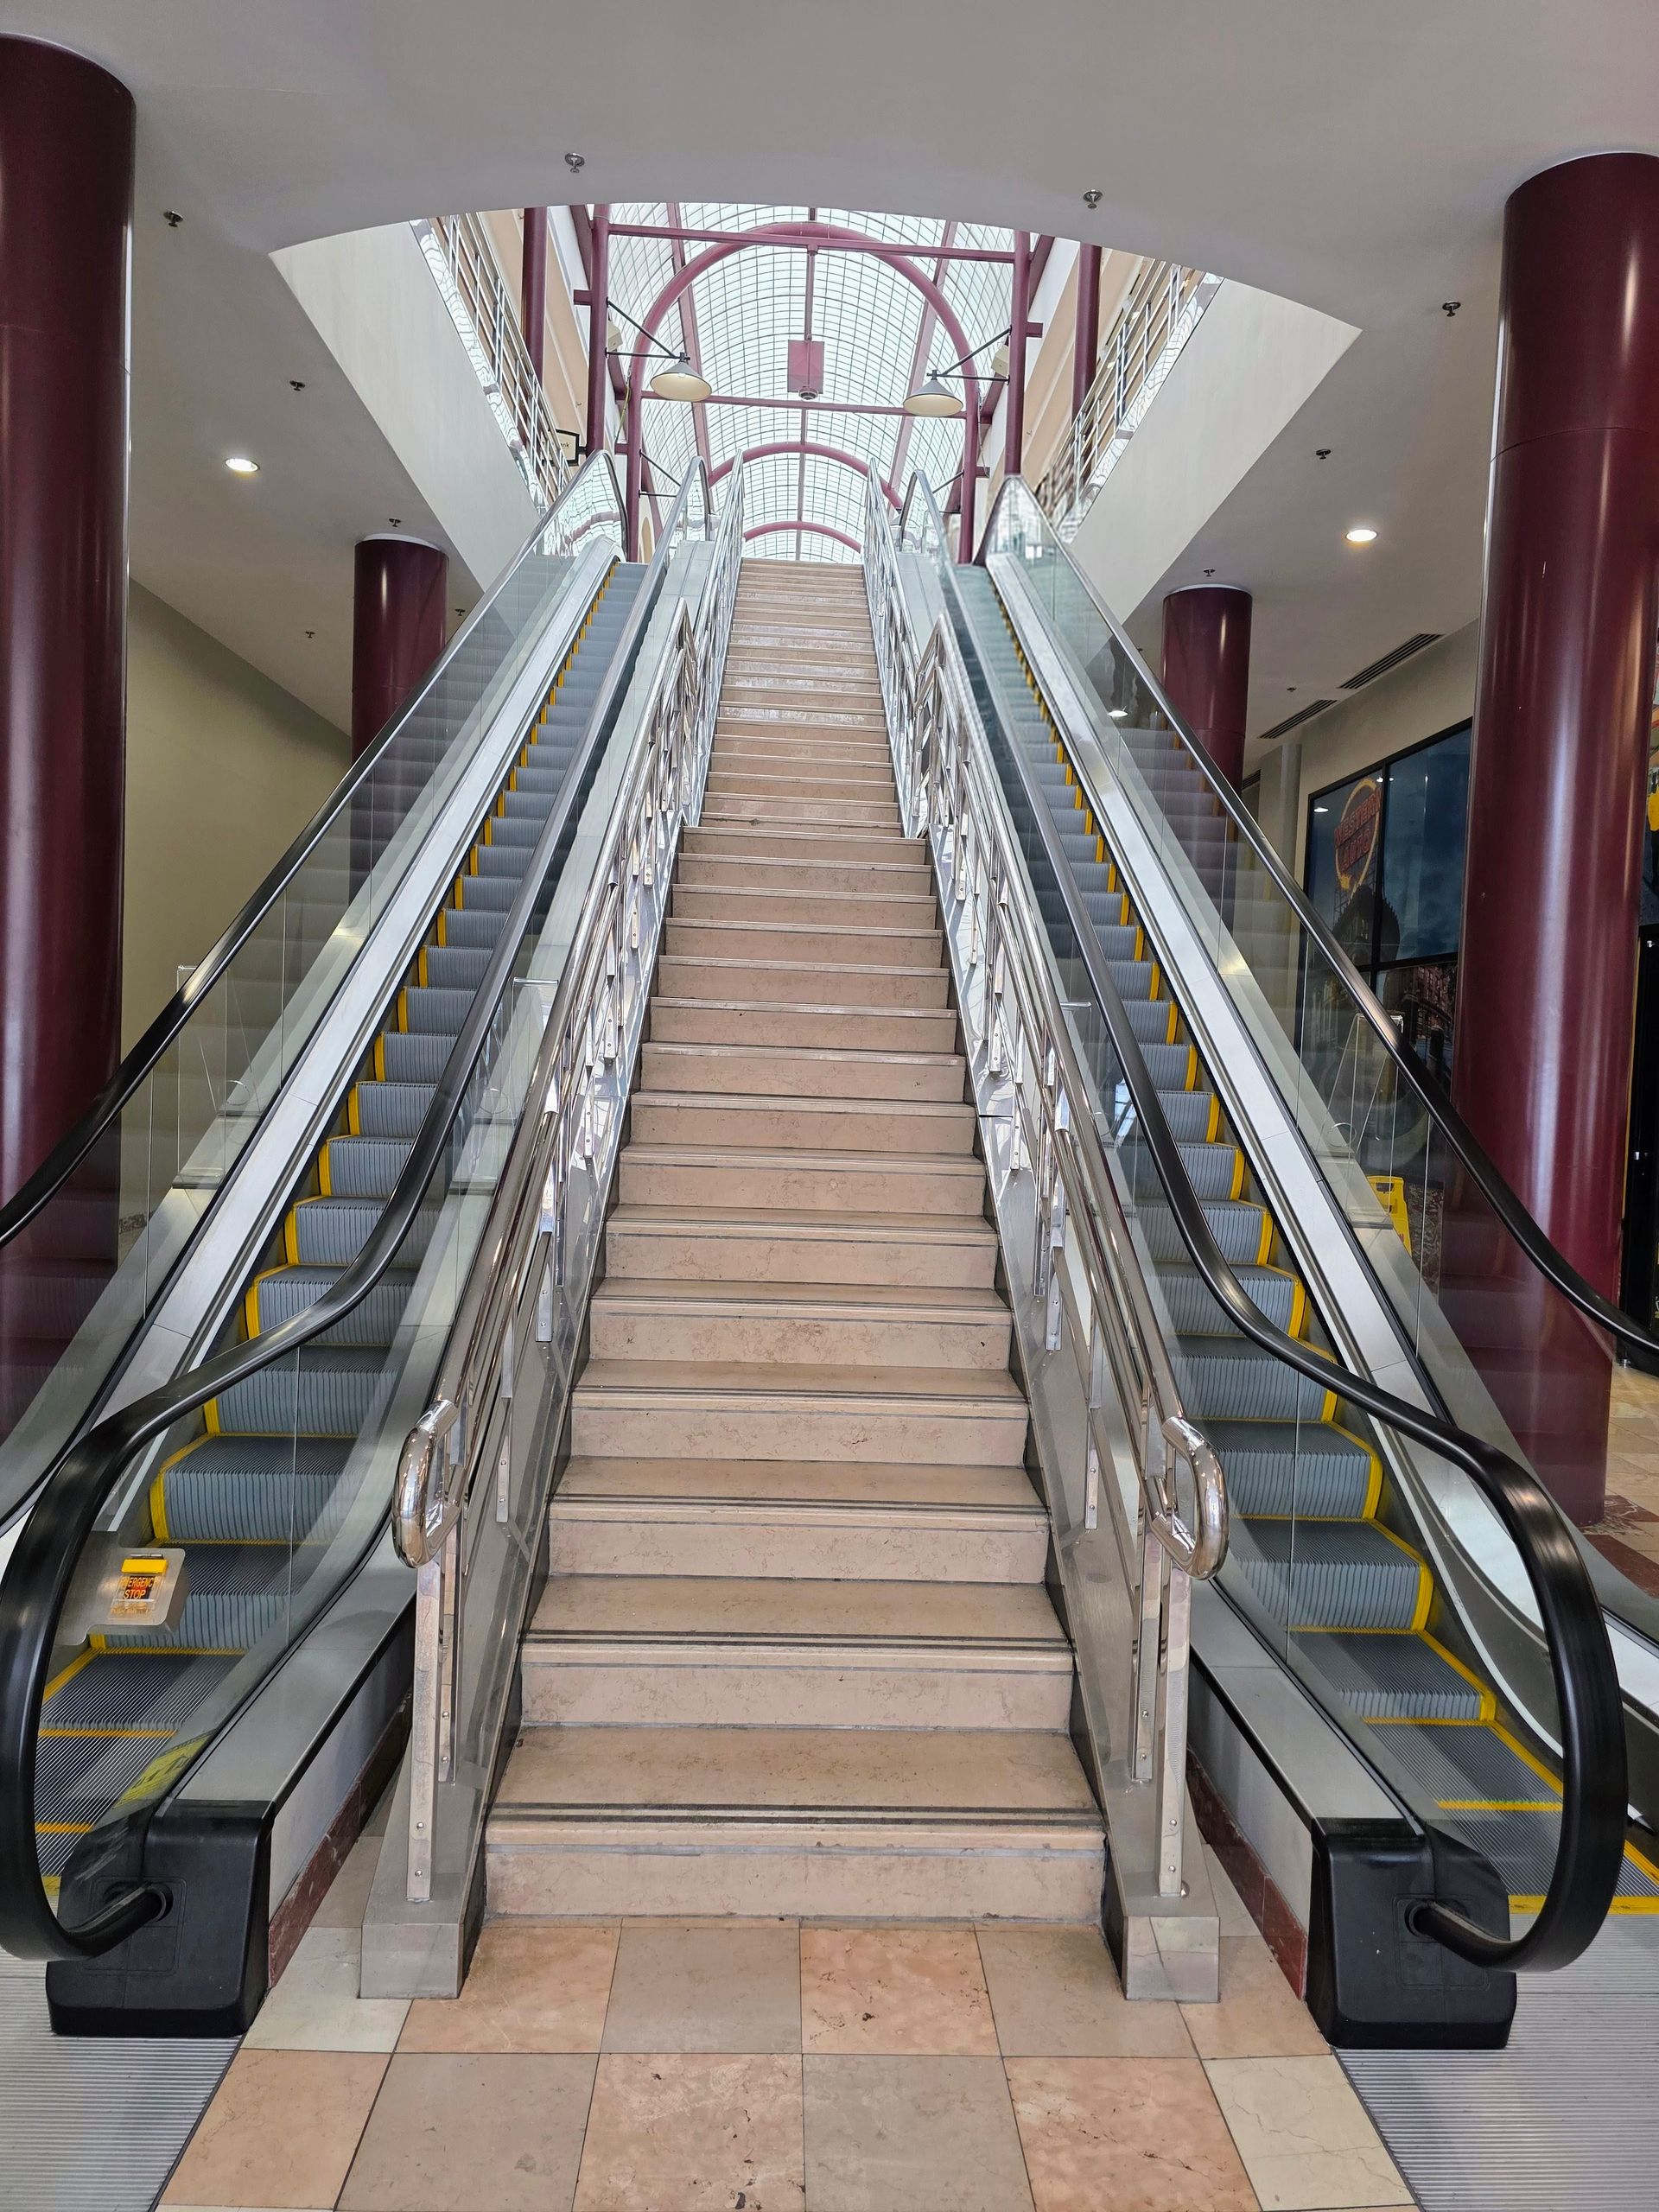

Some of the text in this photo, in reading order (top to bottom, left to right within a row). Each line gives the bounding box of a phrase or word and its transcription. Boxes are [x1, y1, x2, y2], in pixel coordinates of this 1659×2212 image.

[1333, 787, 1381, 849] WESTERN
[119, 1576, 162, 1588] ERGENC
[123, 1589, 147, 1600] STOP
